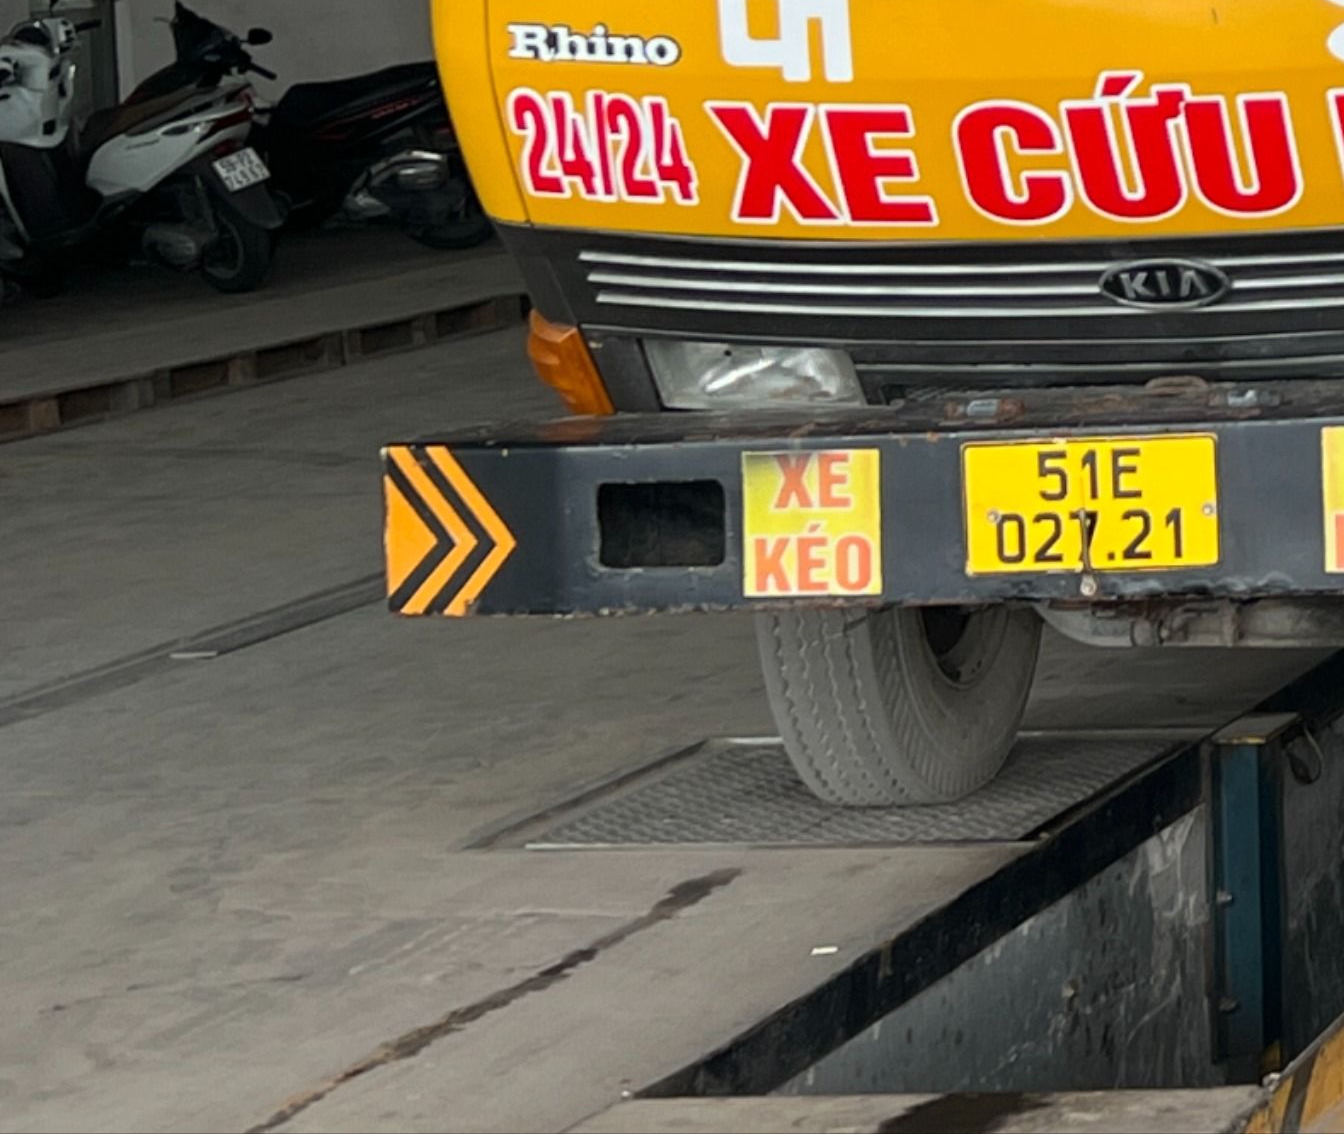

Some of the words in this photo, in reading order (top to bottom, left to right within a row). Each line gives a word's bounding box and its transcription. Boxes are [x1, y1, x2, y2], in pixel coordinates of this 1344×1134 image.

[507, 22, 681, 66] Rhino
[506, 88, 698, 205] 24/24
[703, 100, 940, 227] XE
[952, 69, 1303, 225] CỨU
[1120, 270, 1208, 299] KIA
[773, 452, 851, 509] XE
[1037, 448, 1143, 503] 51E
[753, 522, 872, 593] KÉO
[997, 507, 1184, 565] 027.21
